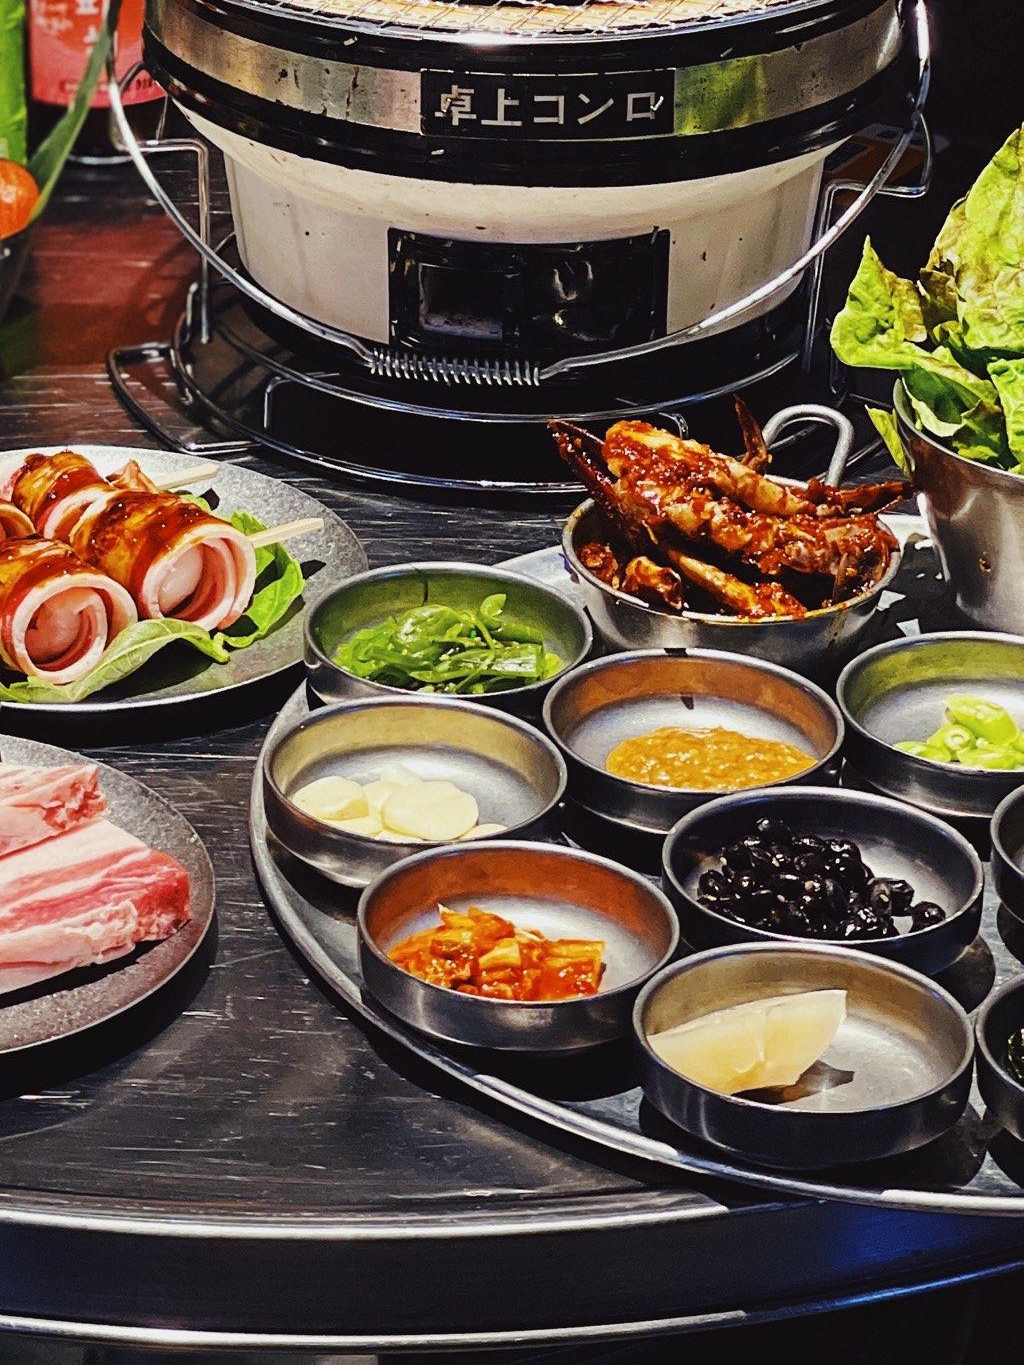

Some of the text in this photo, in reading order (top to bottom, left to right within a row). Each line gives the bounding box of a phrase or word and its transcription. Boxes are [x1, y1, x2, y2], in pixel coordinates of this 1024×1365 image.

[434, 84, 656, 127] 卓上コンロ
